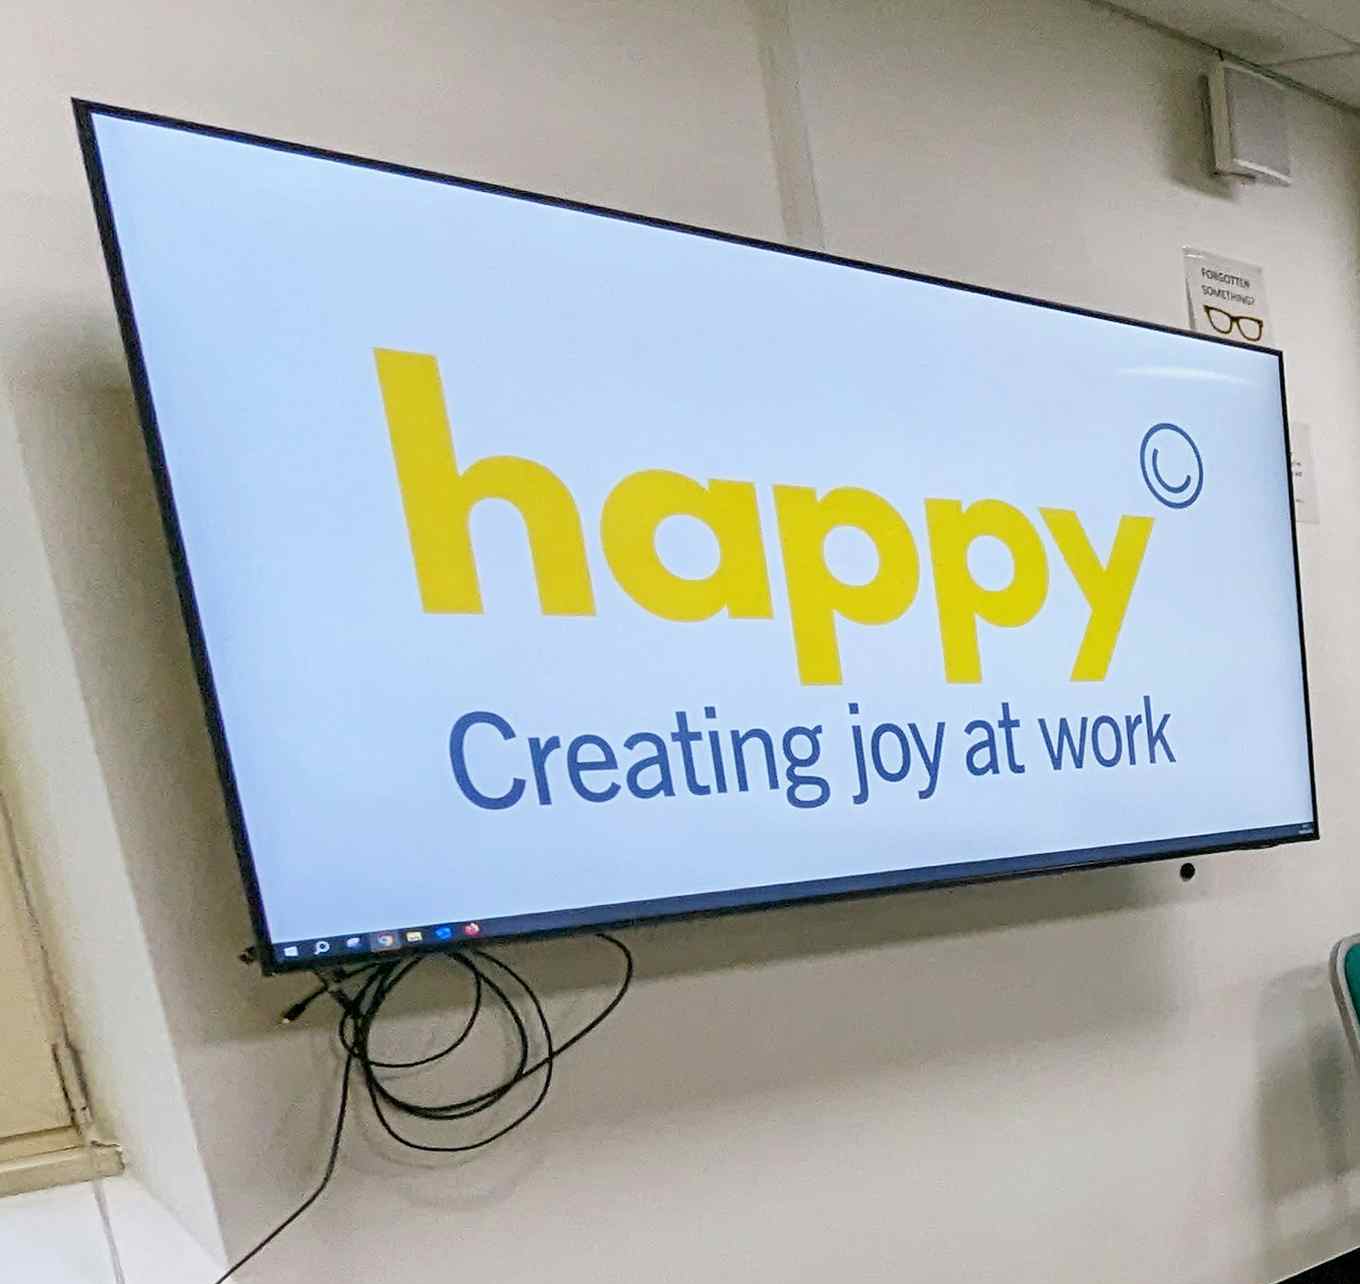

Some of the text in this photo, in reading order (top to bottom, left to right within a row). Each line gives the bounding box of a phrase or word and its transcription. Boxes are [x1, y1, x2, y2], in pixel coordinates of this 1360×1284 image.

[1201, 267, 1250, 289] FORGOTTEN
[373, 347, 1155, 687] happy
[447, 695, 1177, 810] Creating joy at work
